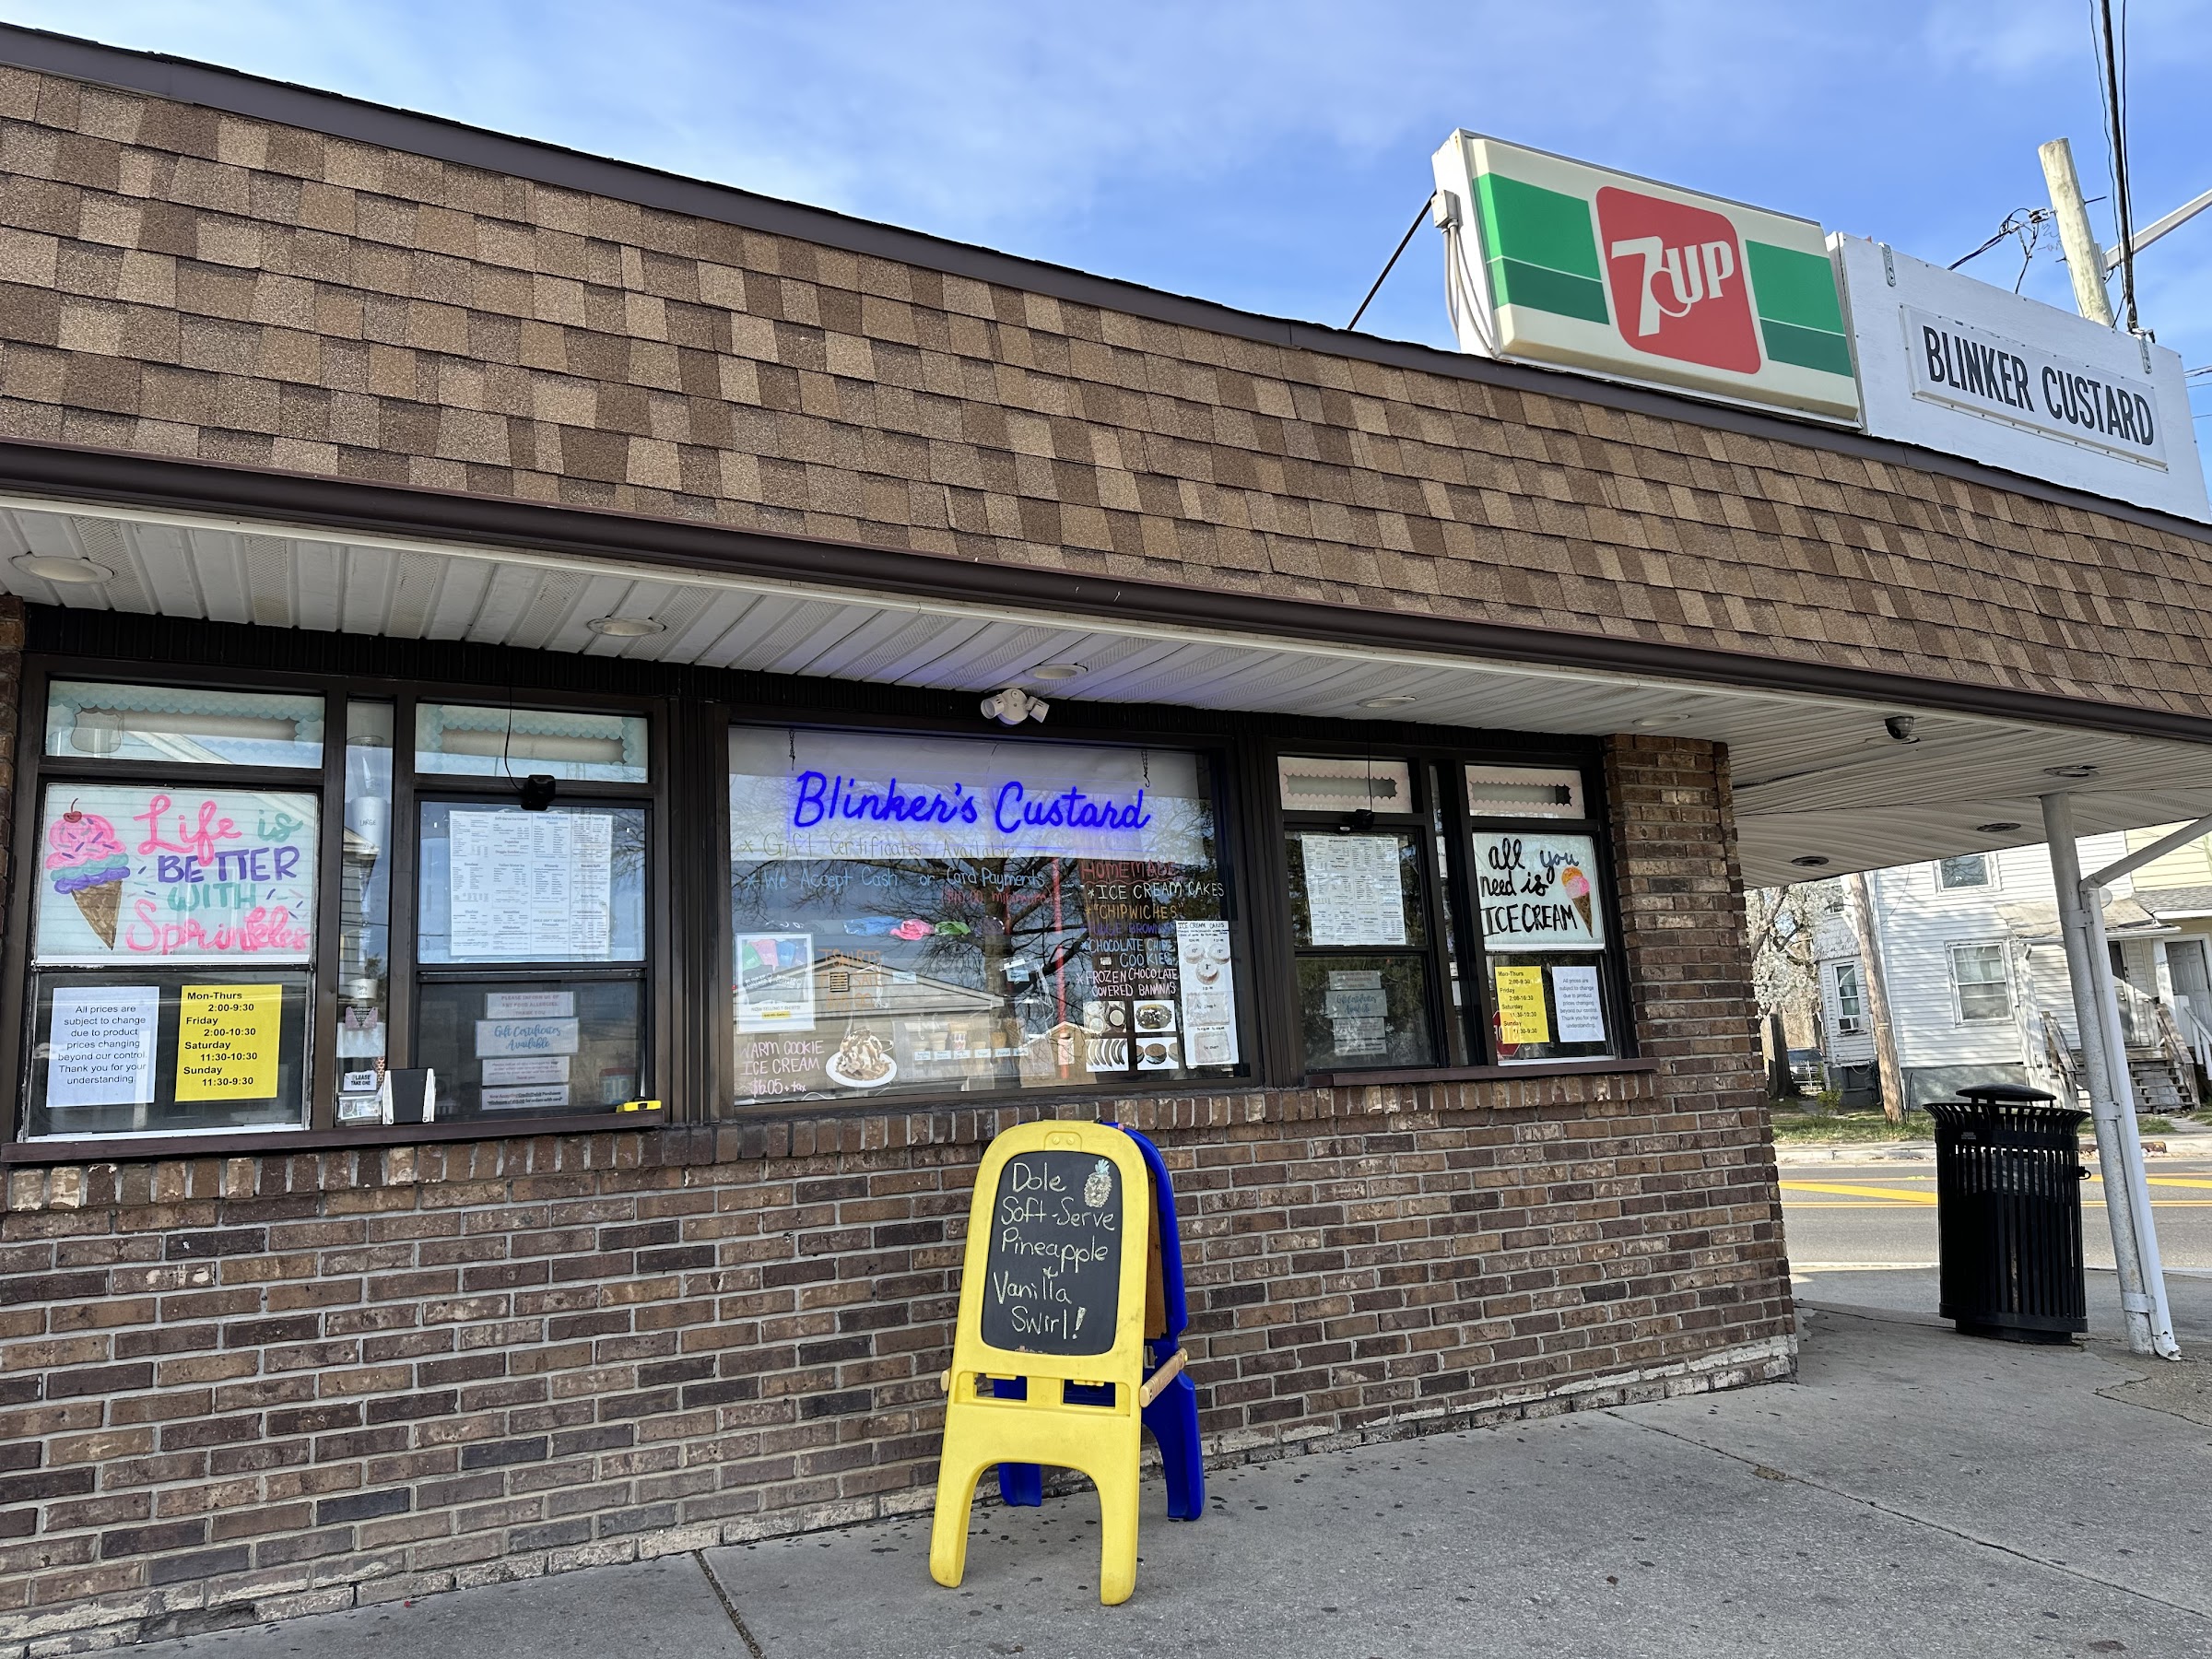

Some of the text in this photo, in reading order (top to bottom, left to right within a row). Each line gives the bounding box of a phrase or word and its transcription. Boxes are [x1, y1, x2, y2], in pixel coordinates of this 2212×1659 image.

[1923, 325, 2155, 446] BLINKER CUSTARD
[794, 771, 1151, 833] Blinker's Custard
[133, 794, 304, 867] Life is
[359, 818, 376, 827] LARGE
[763, 832, 1015, 859] Gift Certificates Available
[158, 845, 300, 883] BETTER
[1488, 838, 1579, 884] all you
[1080, 861, 1177, 879] HOMEMADE
[764, 865, 1046, 892] We Accept Cash or Card Payments
[1480, 870, 1548, 897] need is
[167, 882, 257, 912] WITH
[1095, 881, 1225, 900] ICE CREAM CAKES
[125, 899, 311, 955] Sprinkles
[1480, 903, 1578, 936] ICE CREAM
[1089, 938, 1144, 954] CHOCOLATE
[1120, 952, 1172, 968] COOKIES
[1086, 968, 1178, 985] FROZEN CHOCOLATE
[187, 992, 242, 1000] Mon-Thurs
[1091, 982, 1177, 997] COVERED BANANAS
[90, 1006, 119, 1014] prices
[208, 1004, 254, 1012] 2:00-9:30
[64, 1017, 98, 1026] subject
[112, 1017, 146, 1026] change
[186, 1017, 218, 1025] Friday
[71, 1028, 138, 1037] due to product
[204, 1028, 256, 1037] 2:00-10:30
[494, 1024, 561, 1038] Gift Certificates
[66, 1040, 140, 1050] prices changing
[184, 1041, 230, 1050] Saturday
[506, 1037, 550, 1051] Available
[783, 1041, 825, 1055] COOKIE
[58, 1052, 93, 1062] beyond
[113, 1051, 147, 1060] control.
[200, 1052, 257, 1061] 11:30-10:30
[59, 1063, 147, 1073] Thank you for your
[183, 1065, 223, 1075] Sunday
[740, 1058, 820, 1076] ICE CREAM
[66, 1075, 135, 1085] understanding.
[202, 1077, 253, 1087] 11:30-9:30
[750, 1077, 783, 1098] $6.05
[1013, 1162, 1066, 1193] Dole
[1001, 1227, 1108, 1274] Pineapple
[993, 1270, 1072, 1304] Vanilla
[1012, 1305, 1087, 1340] Swirl!
